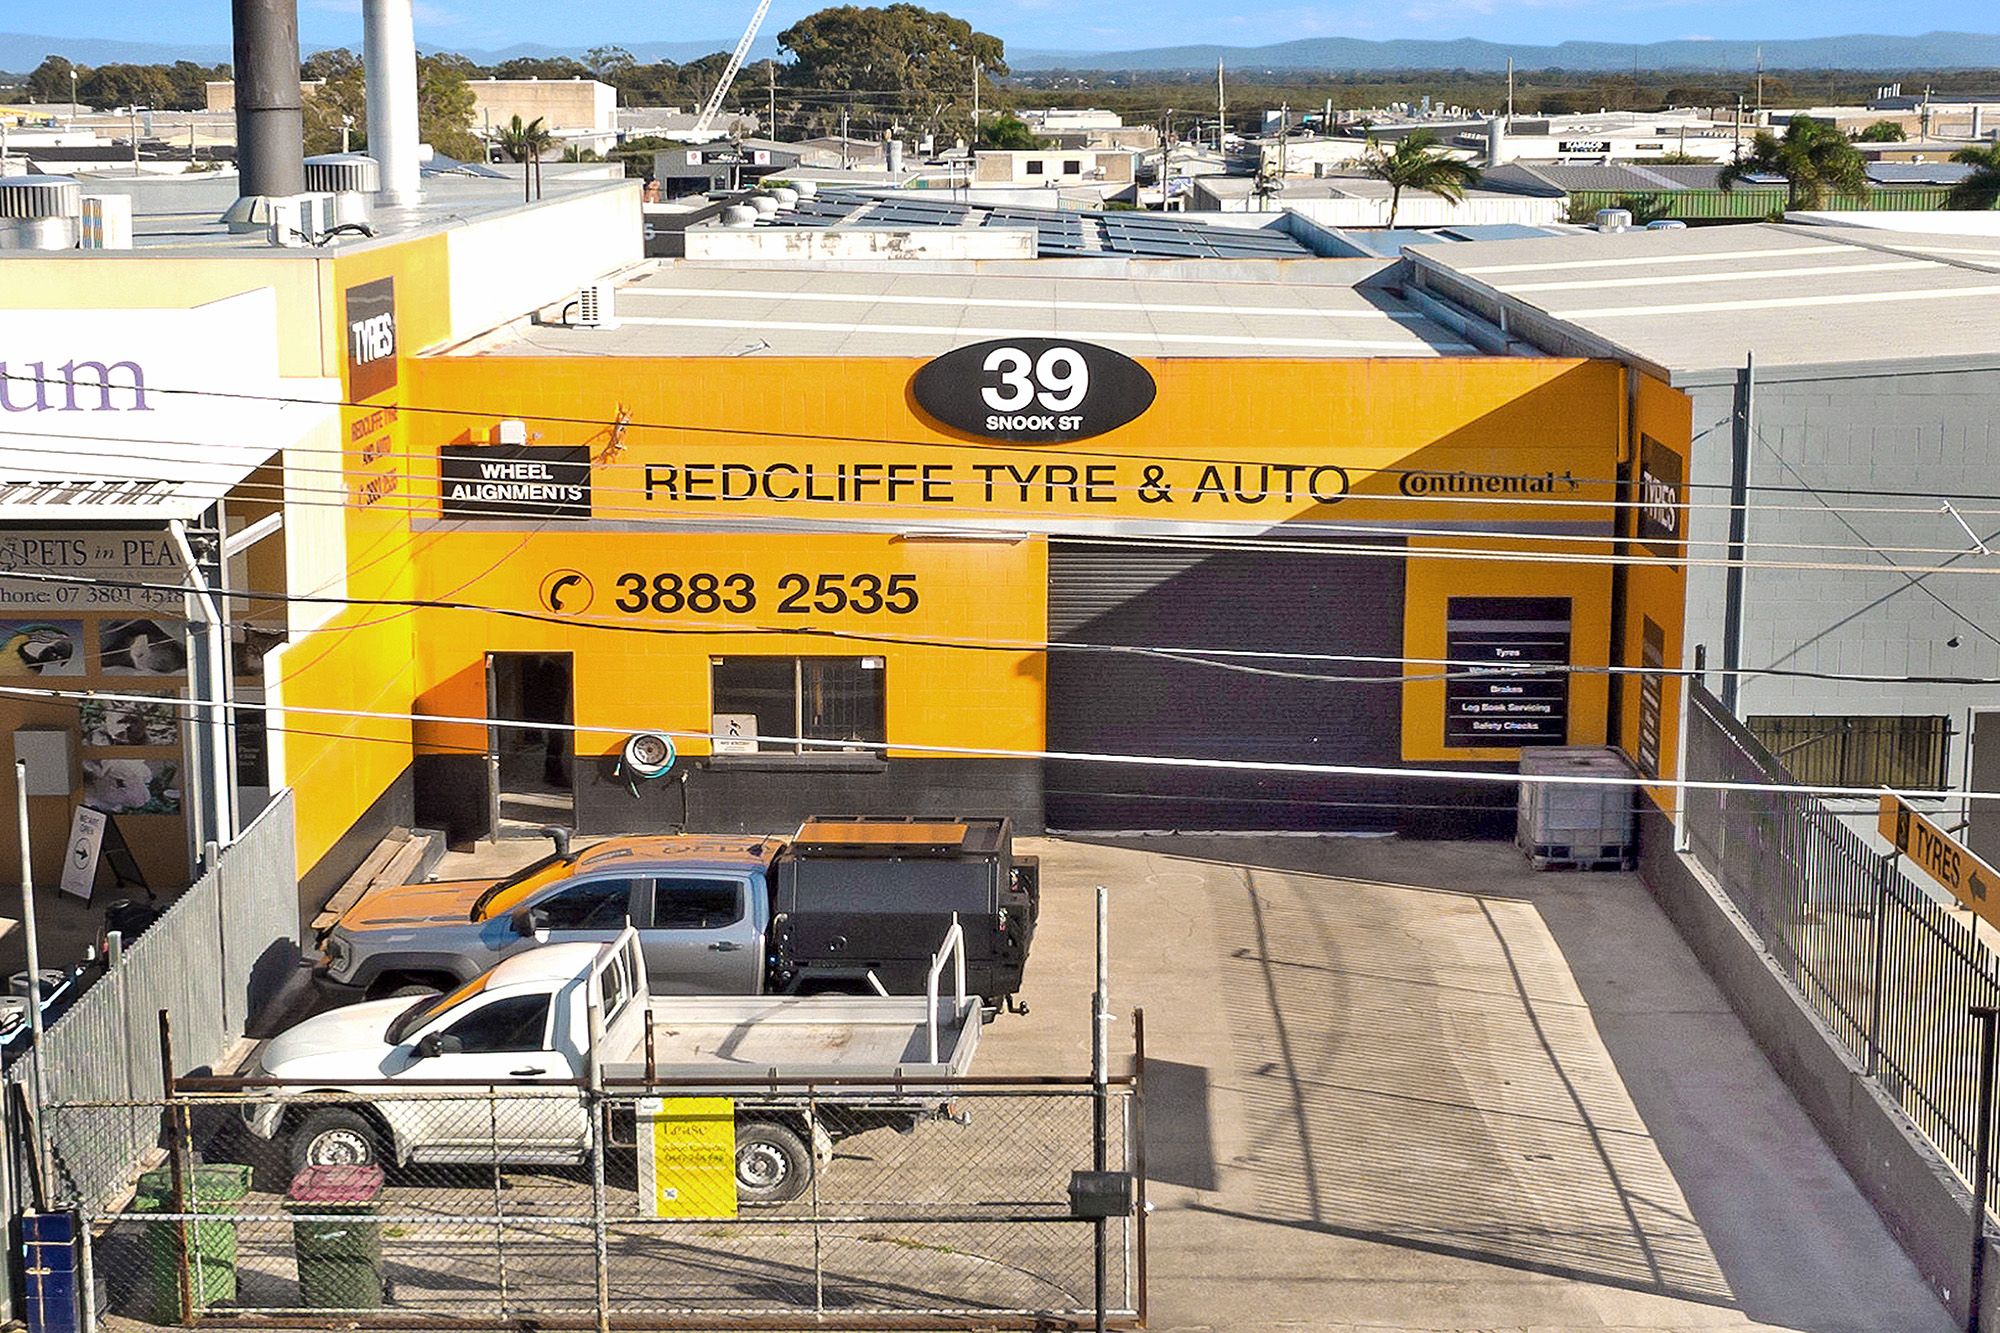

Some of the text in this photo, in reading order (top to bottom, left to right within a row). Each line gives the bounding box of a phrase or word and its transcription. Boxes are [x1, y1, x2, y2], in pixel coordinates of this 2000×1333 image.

[352, 312, 393, 366] TYRES
[980, 346, 1089, 412] 39
[985, 415, 1083, 431] SNOOK ST
[480, 463, 554, 480] WHEEL
[450, 483, 583, 501] ALIGNMENTS
[645, 463, 1350, 504] REDCLIFFE TYRE & AUTO
[1399, 471, 1553, 496] Continental
[1643, 470, 1675, 532] TYRES
[22, 539, 180, 566] PETS in PEA
[56, 587, 80, 603] 07
[86, 587, 131, 603] 3801
[615, 572, 919, 615] 3883 2535
[1495, 648, 1521, 658] Tyres
[1490, 685, 1524, 693] Brakes
[1461, 703, 1551, 713] Log Book Servicing
[1472, 721, 1539, 731] Safety Checks
[1917, 822, 1961, 888] TYRES
